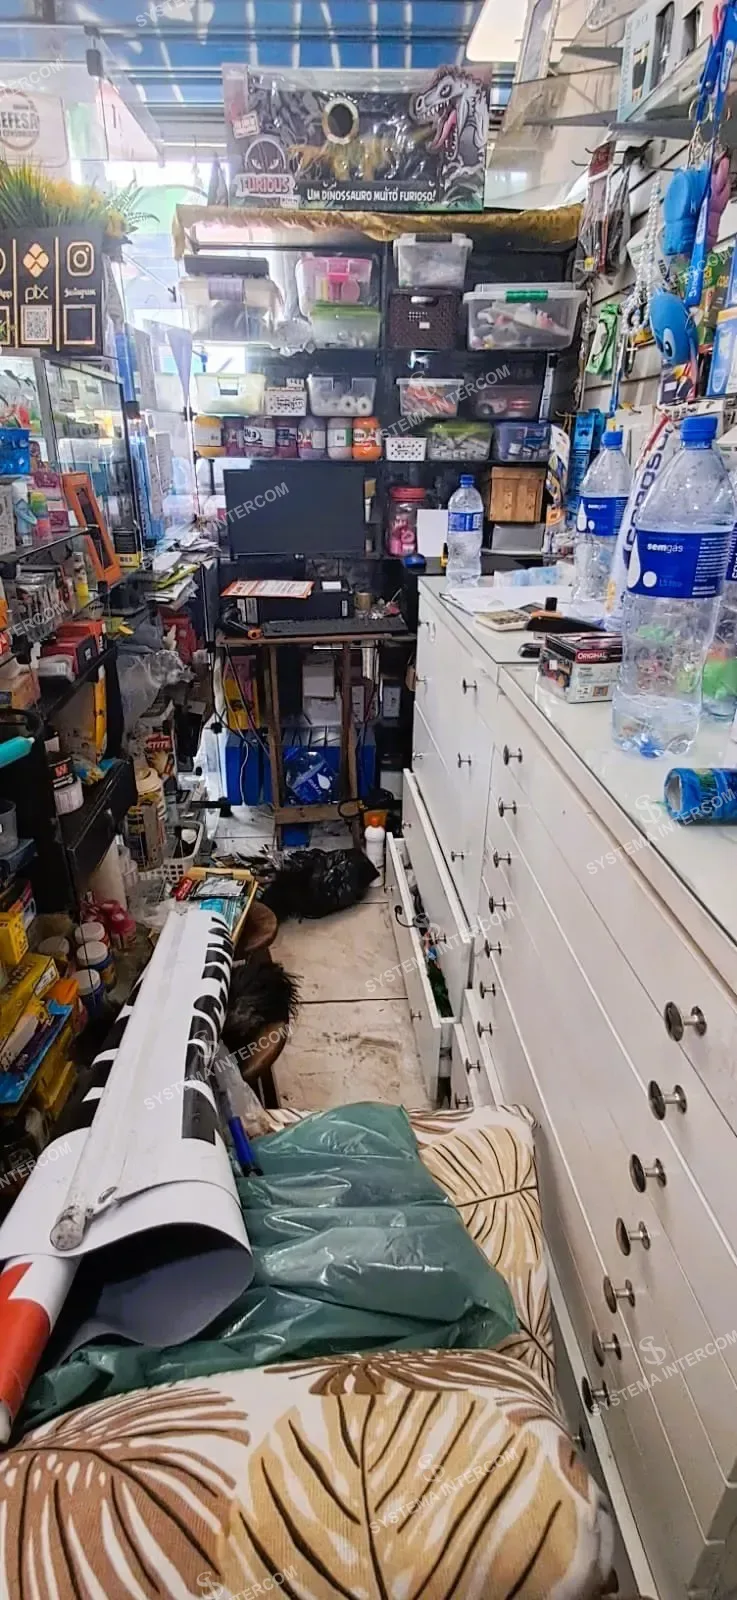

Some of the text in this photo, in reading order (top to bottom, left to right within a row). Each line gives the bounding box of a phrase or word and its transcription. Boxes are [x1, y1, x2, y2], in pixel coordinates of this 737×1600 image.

[0, 112, 39, 129] EFESA
[241, 177, 289, 193] FURIOUS
[322, 190, 372, 200] DINOSSAURO
[400, 189, 436, 201] FURIOSO!
[25, 284, 48, 303] pix
